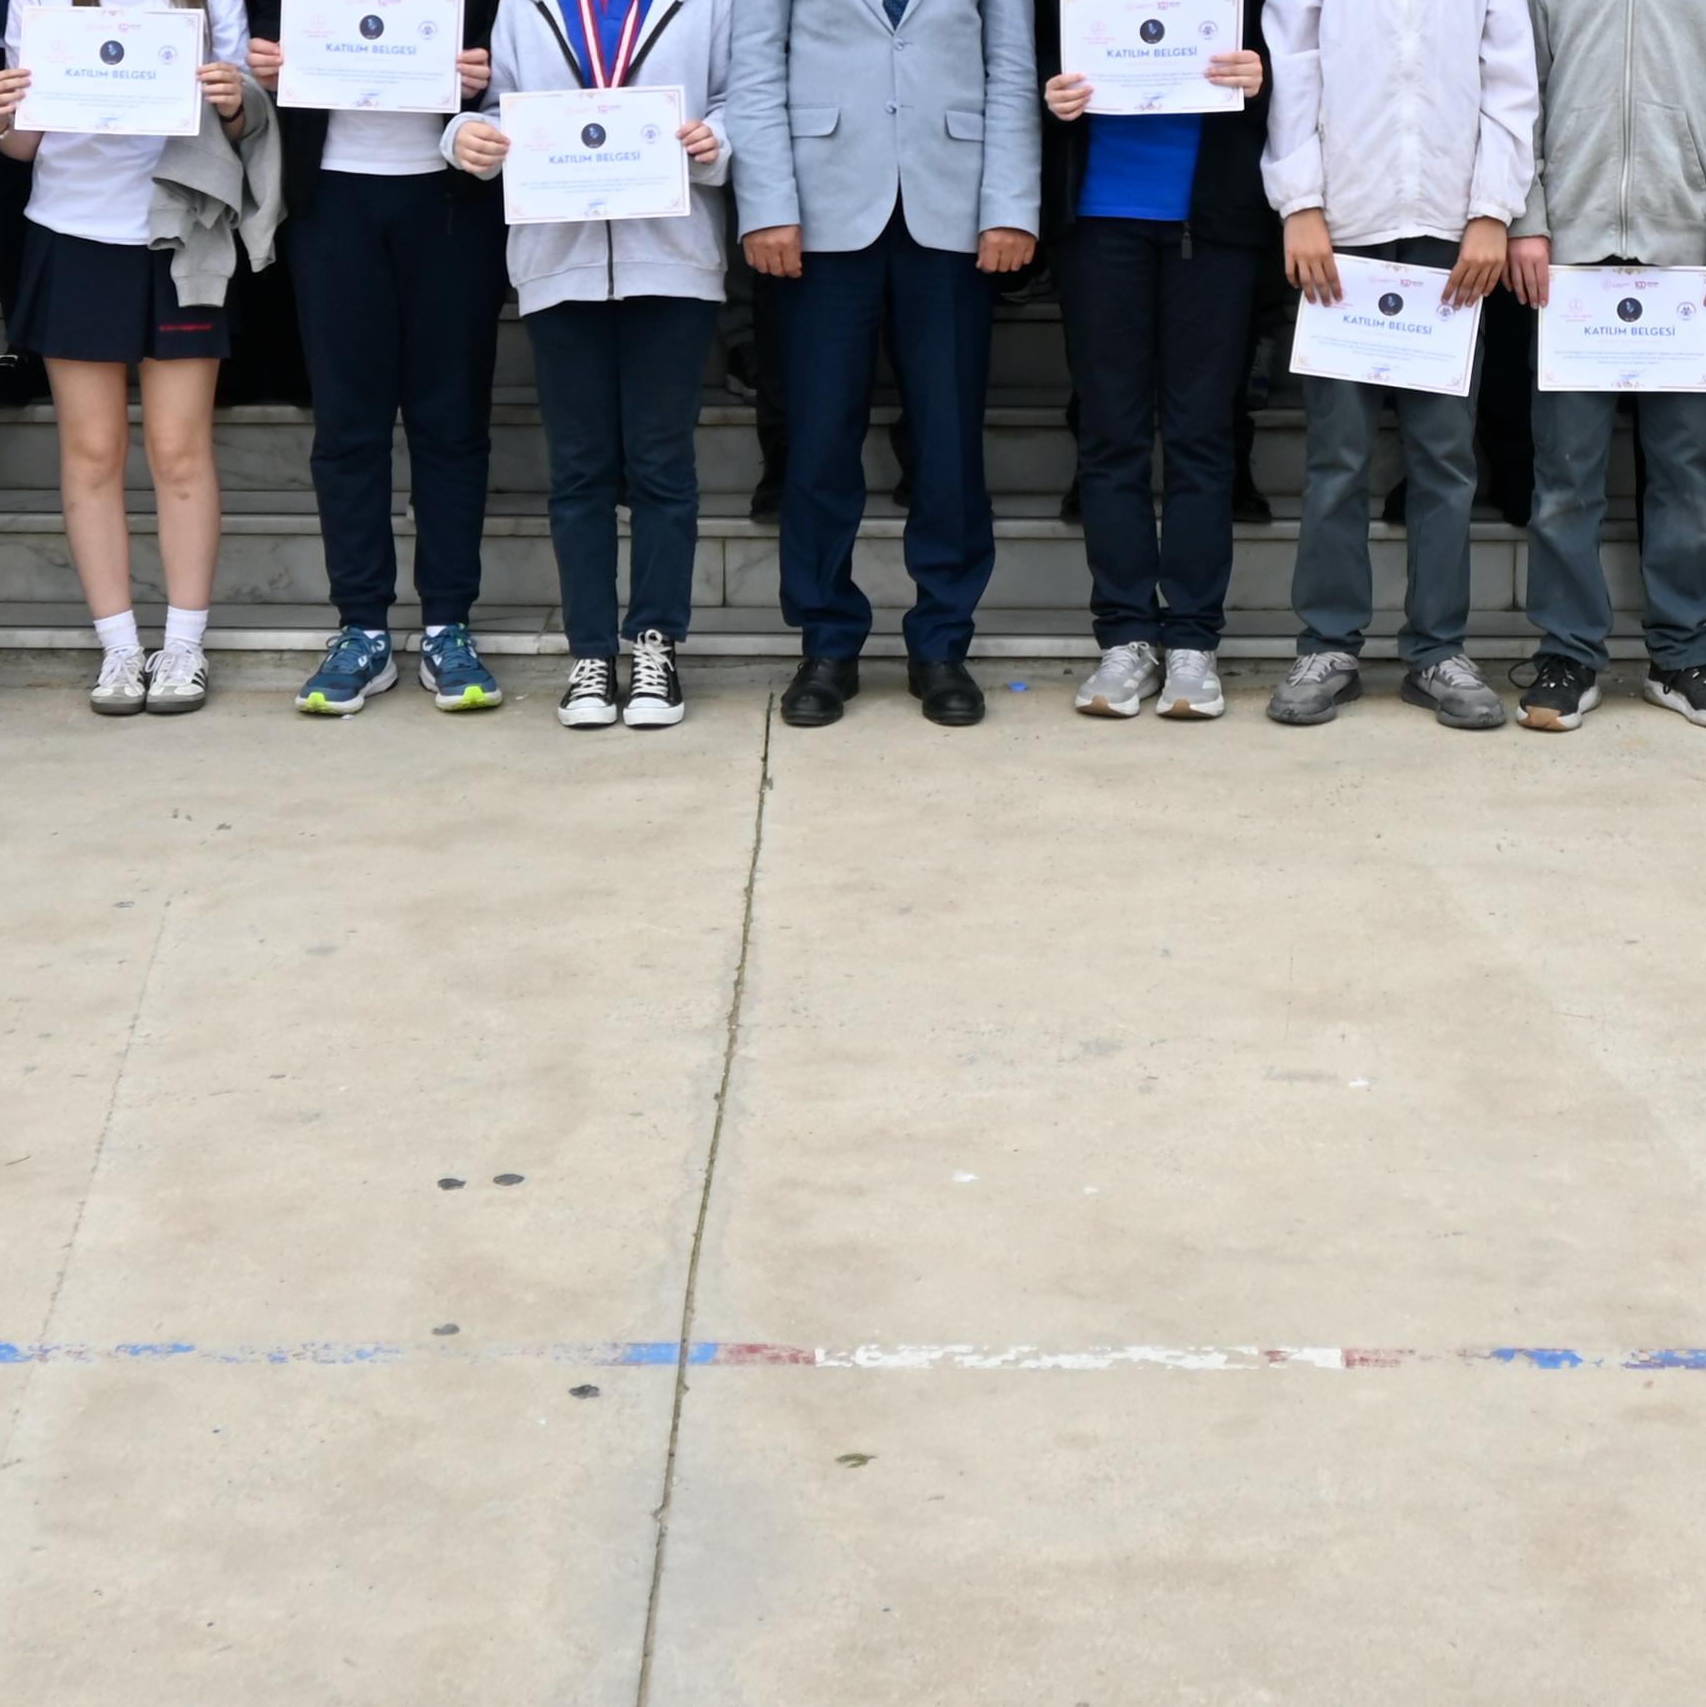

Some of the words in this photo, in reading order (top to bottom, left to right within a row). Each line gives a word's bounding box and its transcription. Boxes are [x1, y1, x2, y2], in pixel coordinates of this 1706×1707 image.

[1107, 49, 1150, 59] KATILIM
[1153, 45, 1198, 58] BELGESİ
[1343, 315, 1385, 328] KATILIM
[1584, 326, 1627, 336] KATILIM
